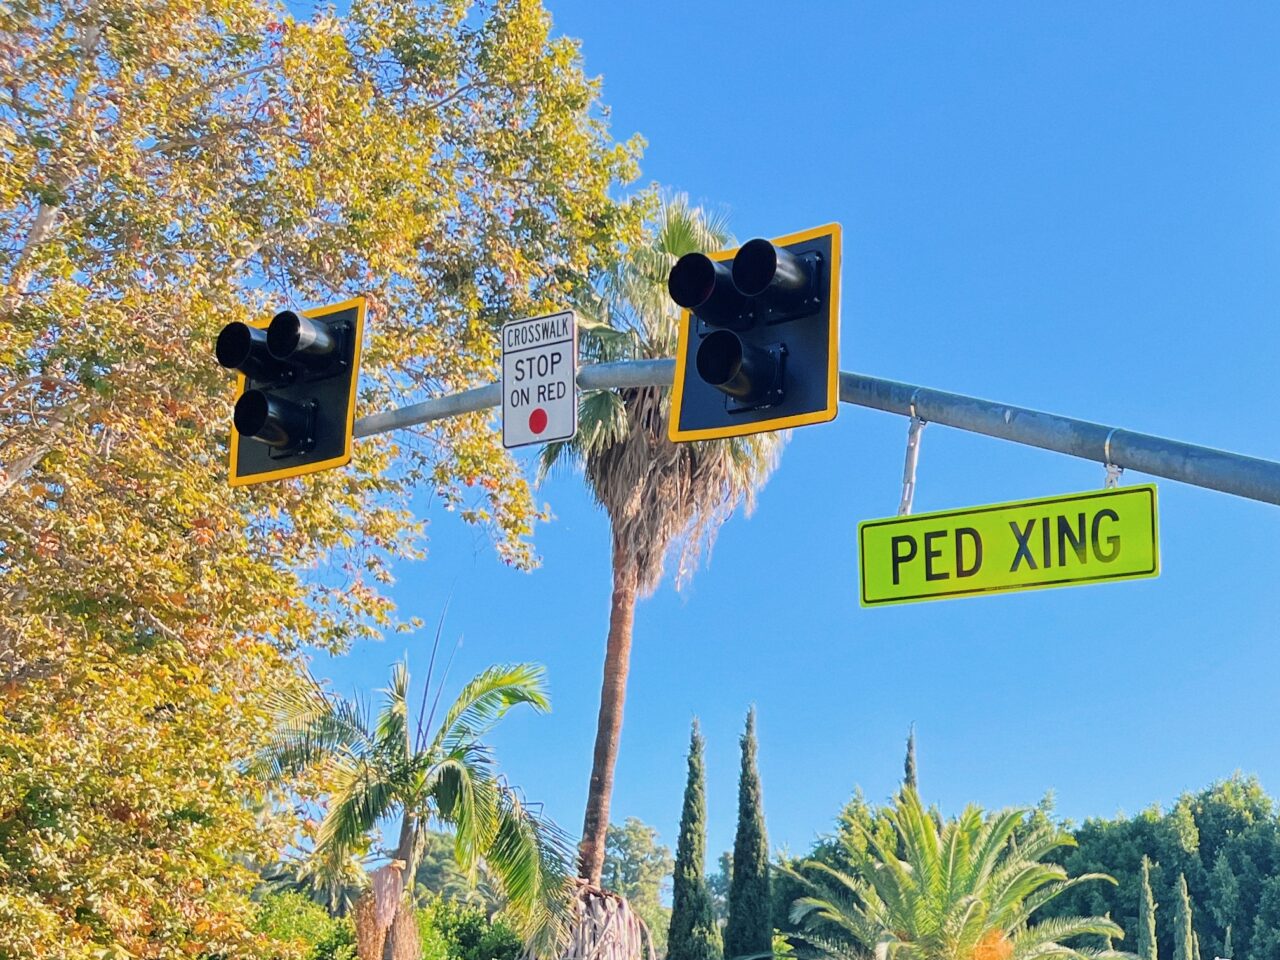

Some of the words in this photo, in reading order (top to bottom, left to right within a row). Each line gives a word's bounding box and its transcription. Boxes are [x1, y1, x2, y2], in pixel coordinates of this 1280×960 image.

[507, 318, 569, 348] CROSSWALK
[515, 352, 562, 381] STOP
[511, 388, 530, 408] ON
[537, 381, 566, 403] RED
[891, 527, 983, 586] PED
[1009, 508, 1121, 573] XING
